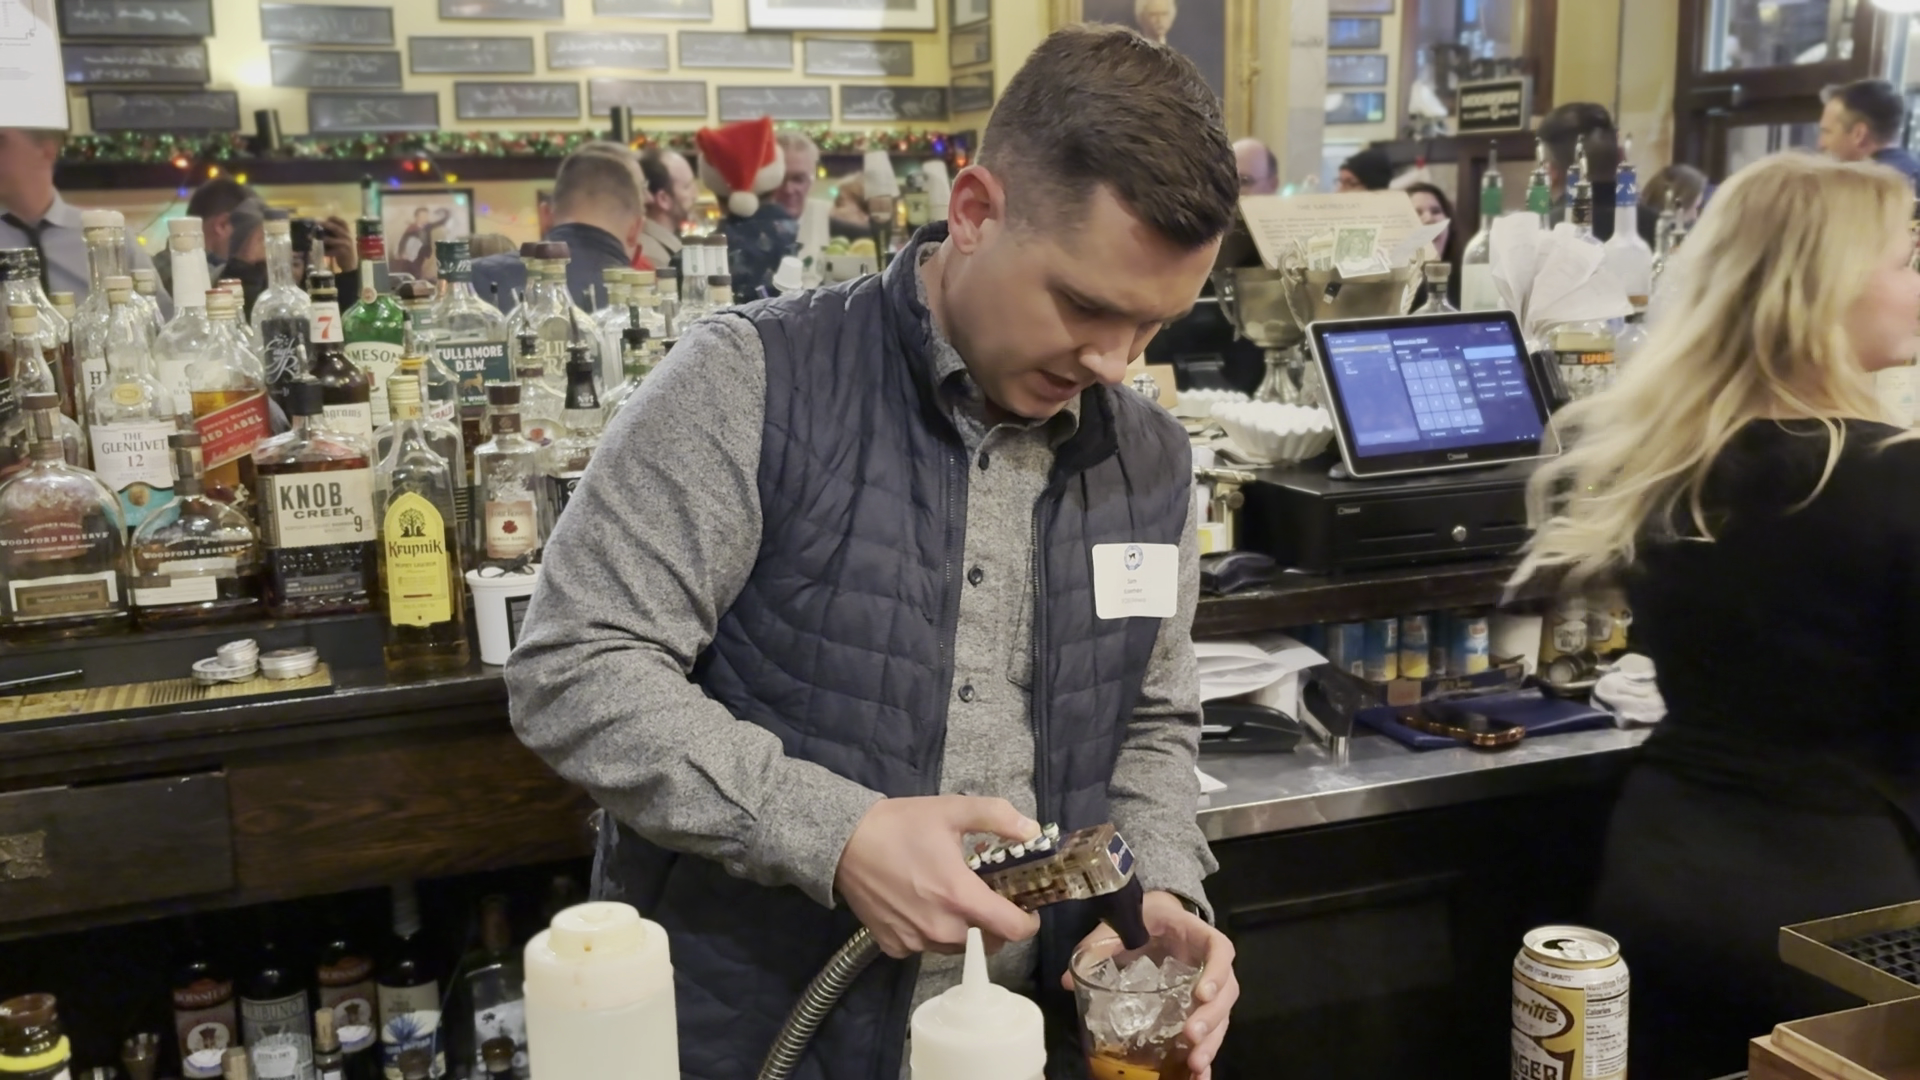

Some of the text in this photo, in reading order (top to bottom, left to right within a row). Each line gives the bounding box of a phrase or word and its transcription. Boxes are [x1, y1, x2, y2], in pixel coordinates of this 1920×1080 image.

[317, 316, 332, 339] 7
[455, 358, 487, 373] D.E.W.
[123, 432, 142, 441] THE
[200, 413, 264, 445] RED LABEL
[101, 438, 166, 455] GLENLIVET
[127, 454, 145, 468] 12
[279, 482, 343, 511] KNOB
[293, 506, 356, 520] CREEK
[354, 515, 363, 533] 9
[0, 531, 110, 547] WOODFORD RESERVE
[142, 545, 243, 560] WOODFORD RESERVE
[388, 538, 444, 559] Krupnik
[1585, 1007, 1612, 1017] Calories
